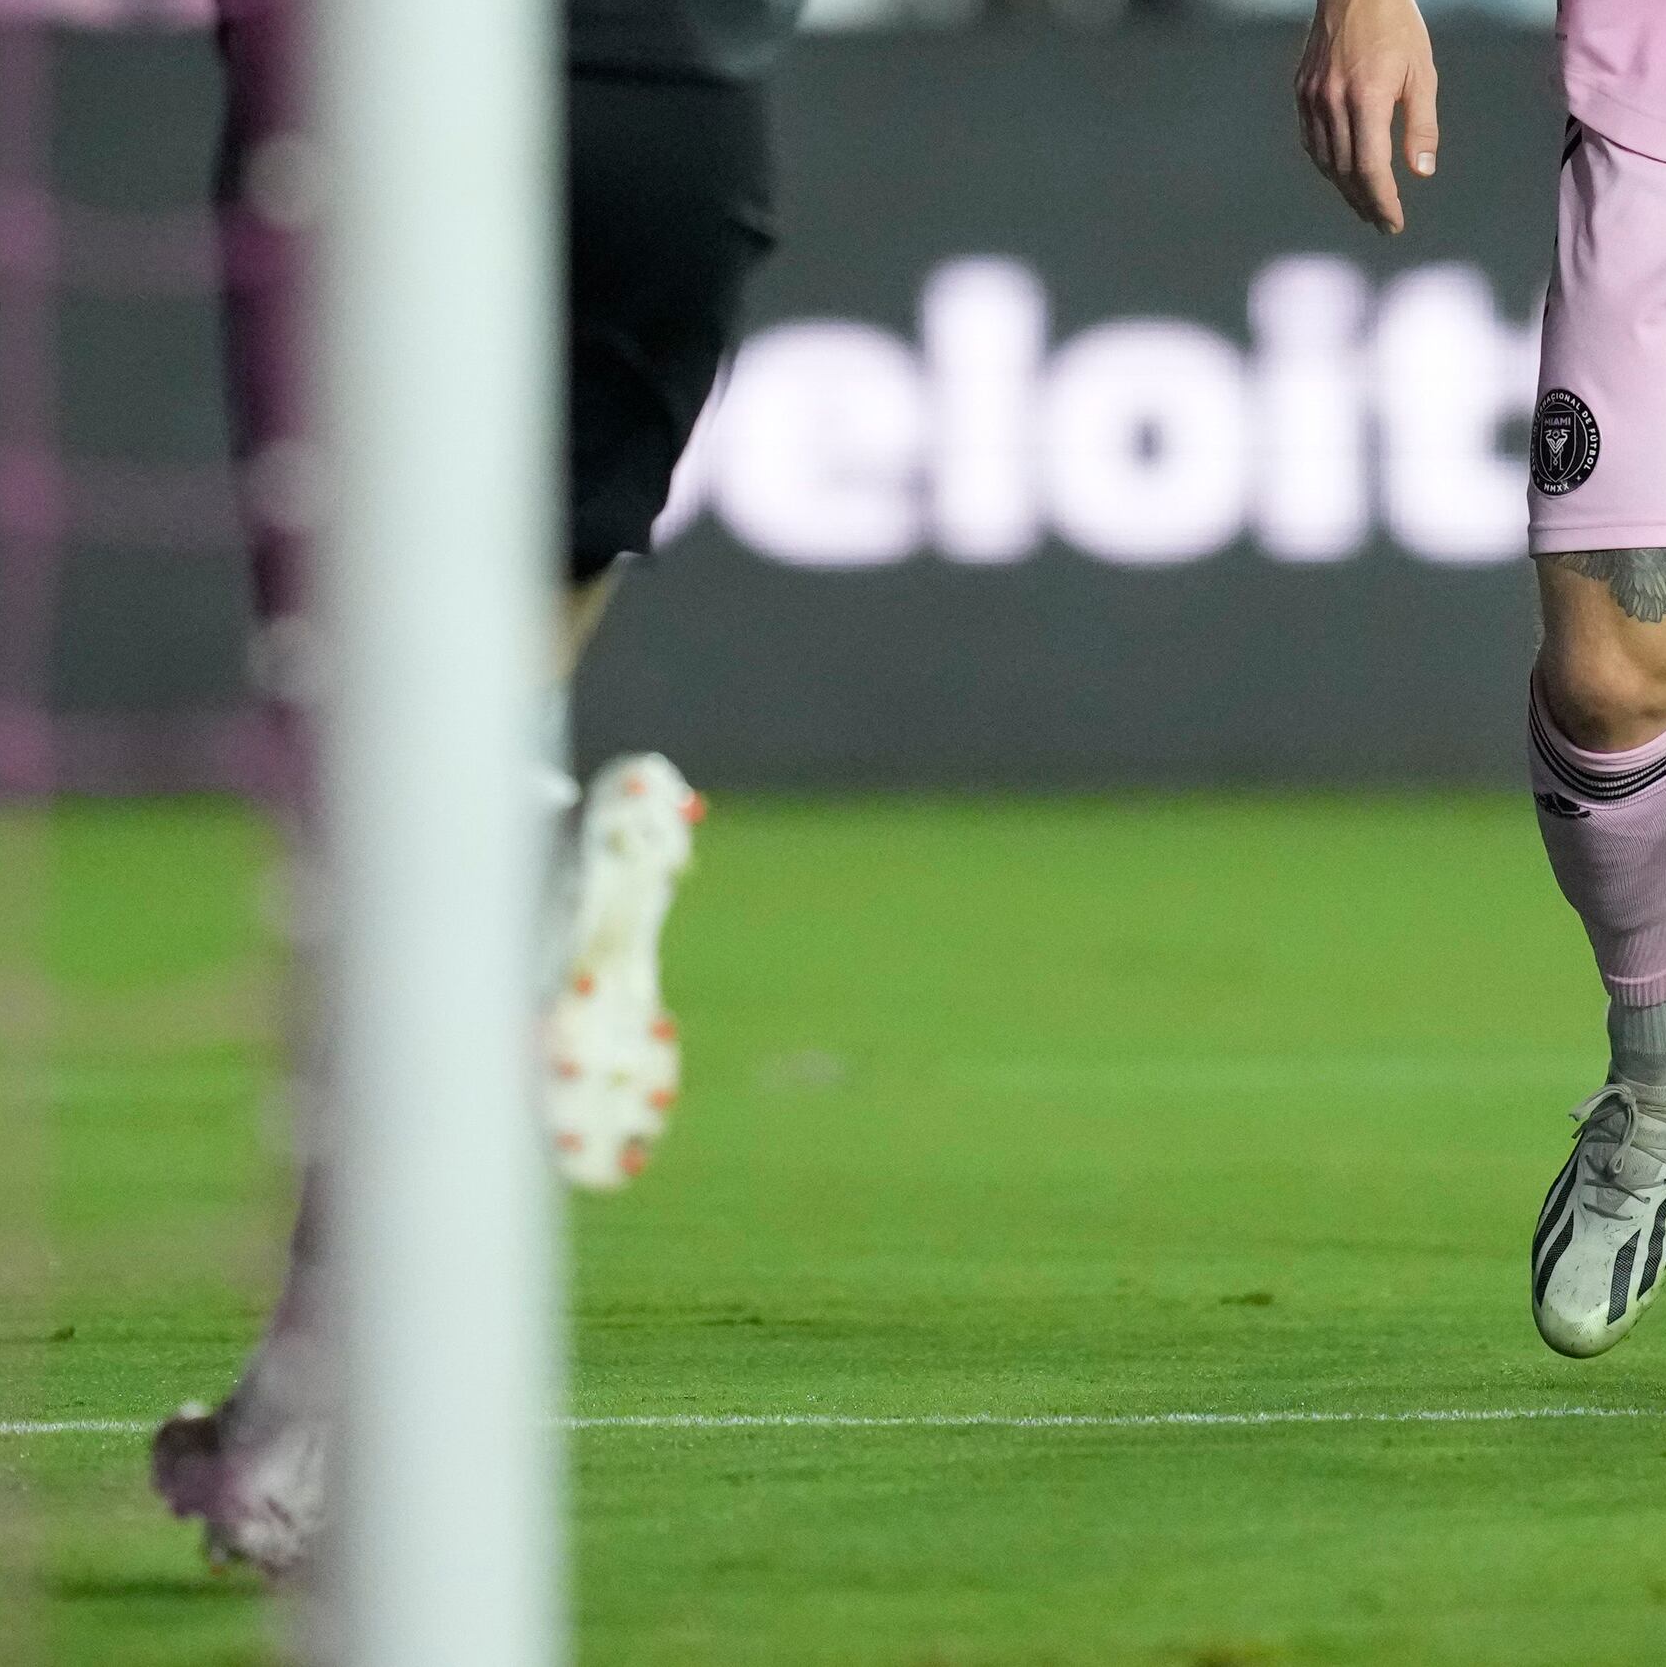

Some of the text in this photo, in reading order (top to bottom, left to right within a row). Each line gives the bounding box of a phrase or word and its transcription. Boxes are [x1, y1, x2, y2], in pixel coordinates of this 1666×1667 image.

[1544, 417, 1572, 426] MIAMI
[1581, 411, 1593, 425] DE
[1543, 481, 1570, 493] MMXX
